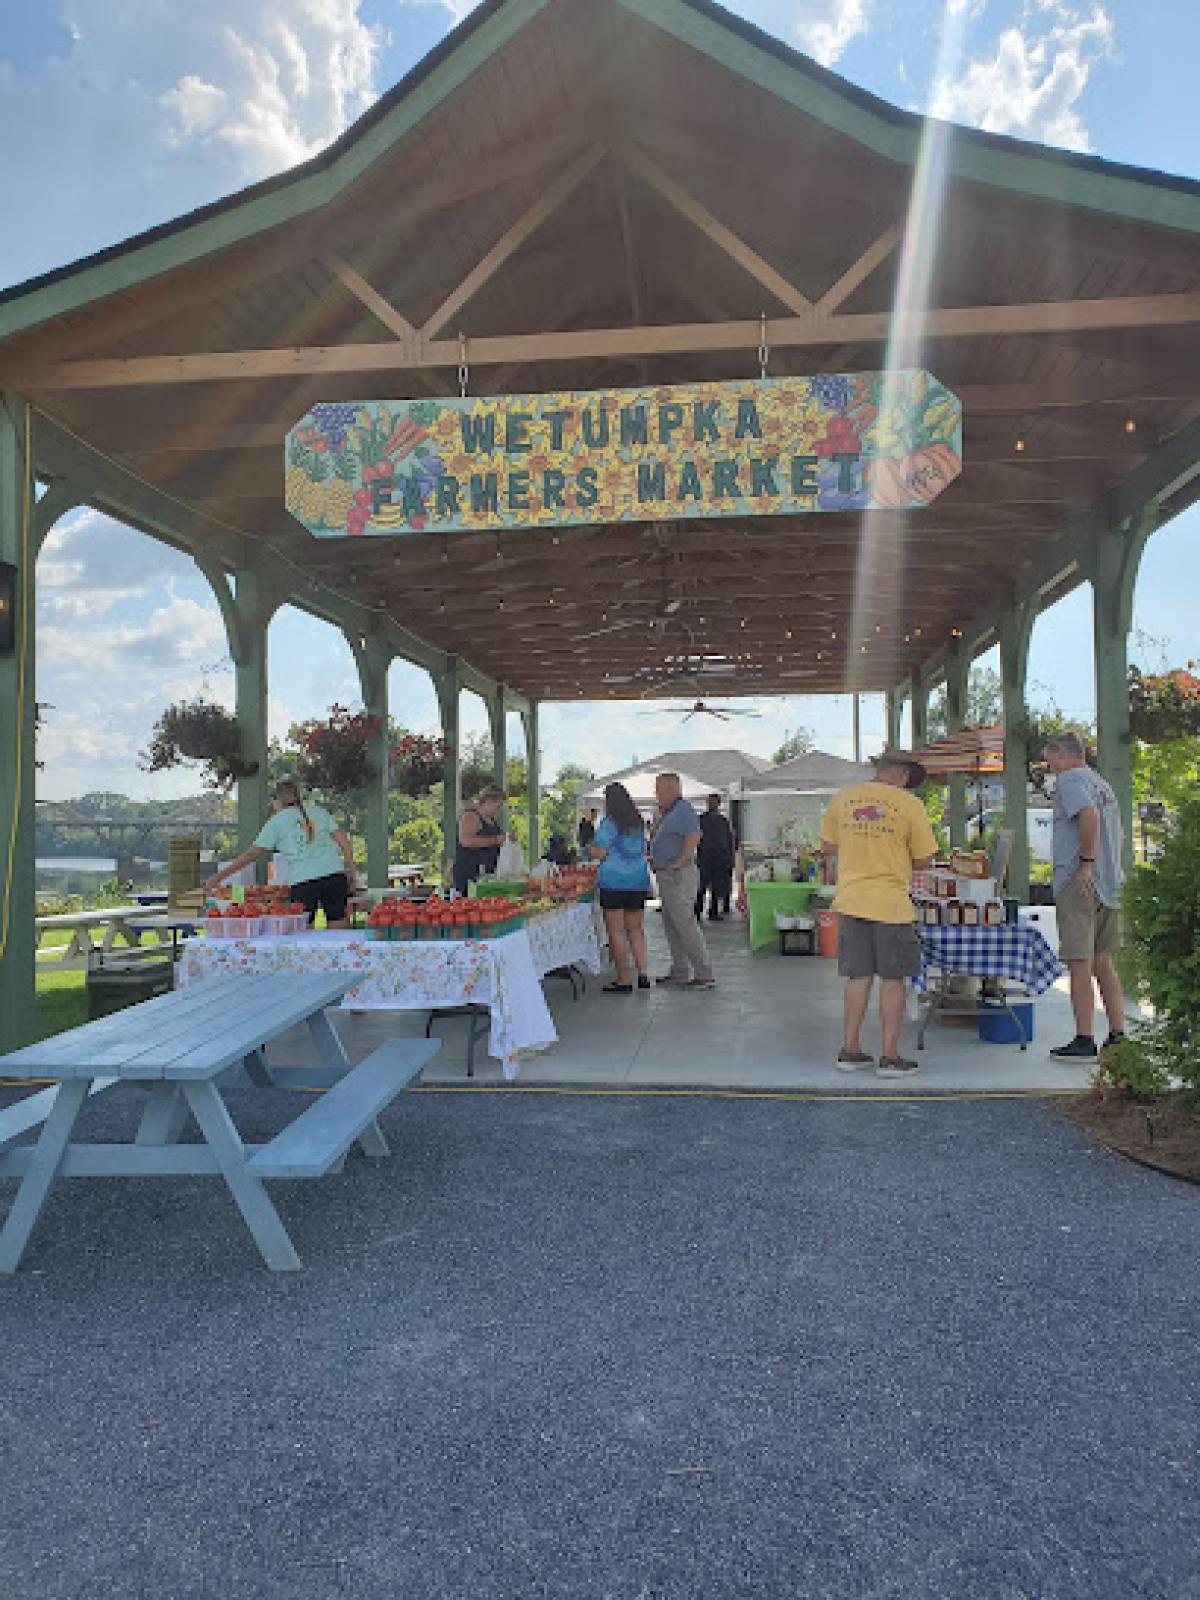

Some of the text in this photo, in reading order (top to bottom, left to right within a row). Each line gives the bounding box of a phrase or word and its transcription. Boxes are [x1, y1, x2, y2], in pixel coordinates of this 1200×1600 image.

[461, 399, 763, 453] WETUMPKA
[371, 453, 860, 517] FARMERS MARKET
